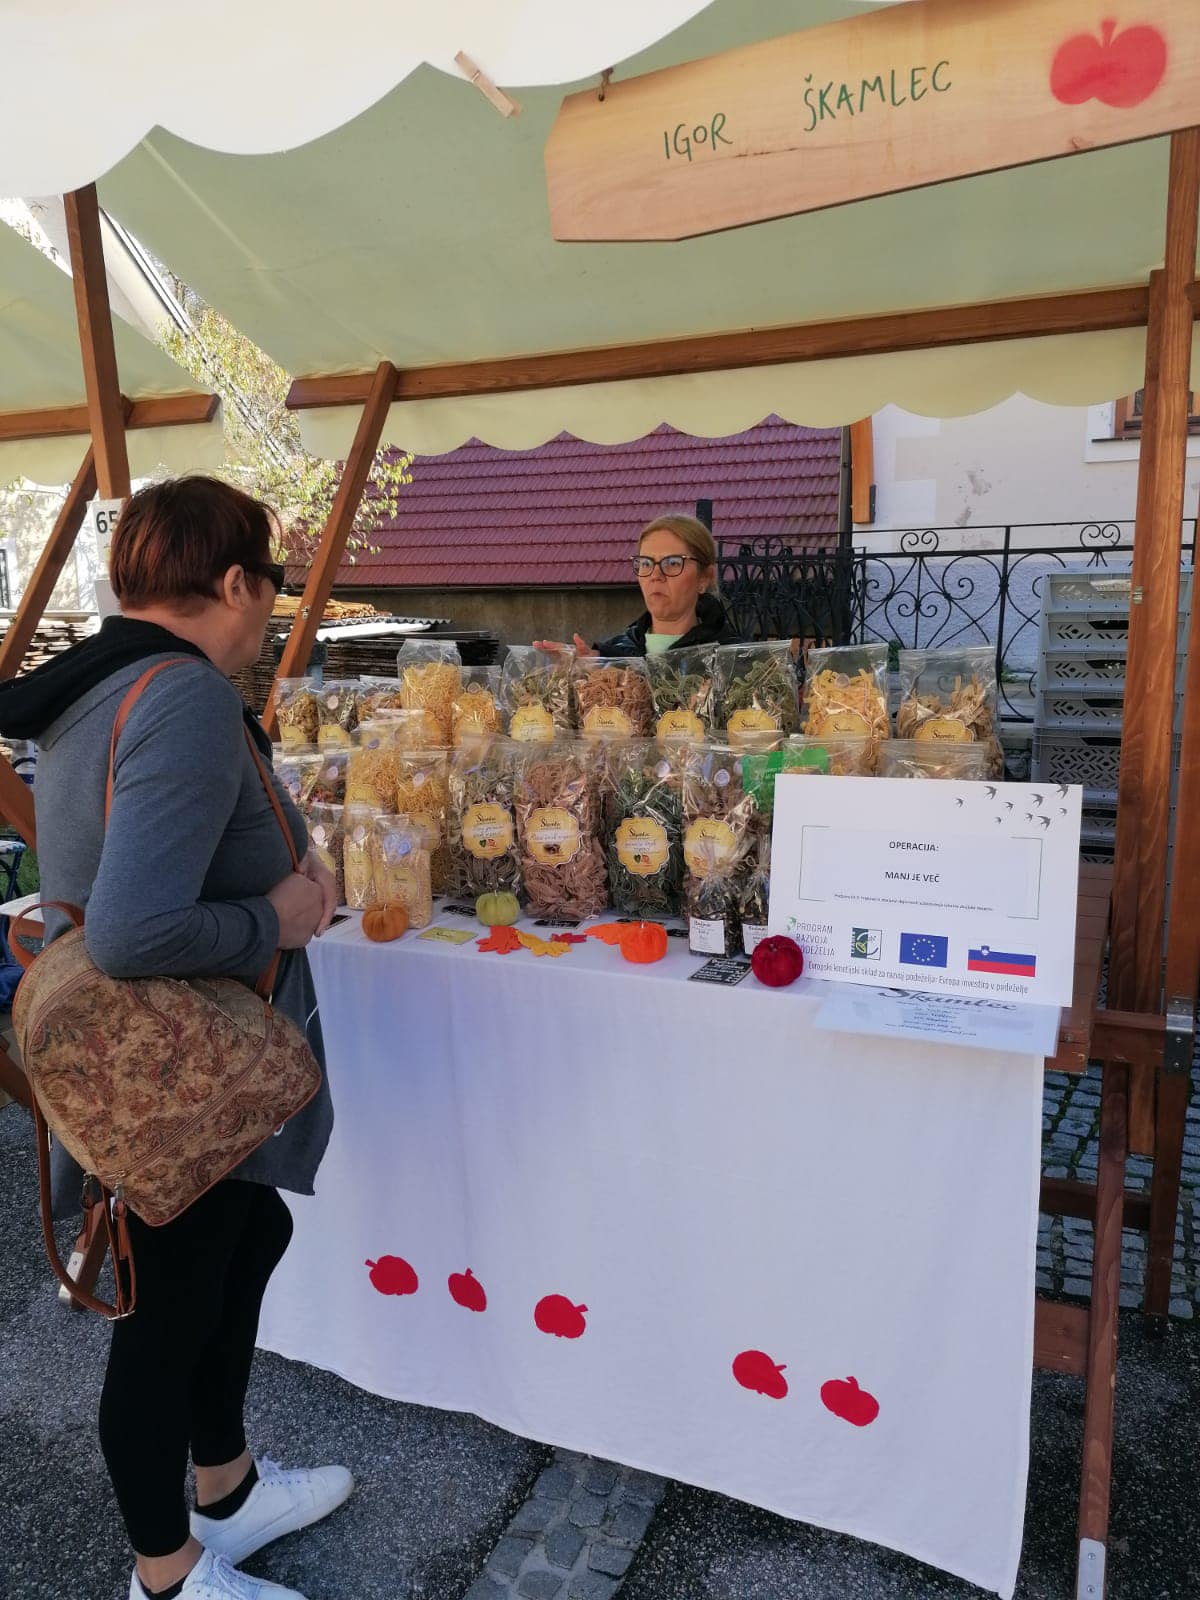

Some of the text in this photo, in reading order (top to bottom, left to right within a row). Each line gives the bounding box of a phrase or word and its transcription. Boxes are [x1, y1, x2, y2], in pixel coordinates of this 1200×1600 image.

[663, 60, 953, 162] IGOR ŠKAMLEC
[889, 841, 940, 852] OPERACIJA:
[884, 871, 941, 883] MANJ JE VEČ
[796, 922, 833, 934] PROGRAM
[796, 933, 828, 945] RAZVOJA
[800, 943, 835, 956] ODEŽELJA
[861, 967, 878, 978] sklad
[939, 976, 960, 987] Evropa
[961, 979, 989, 990] investira
[996, 983, 1029, 995] podeželje
